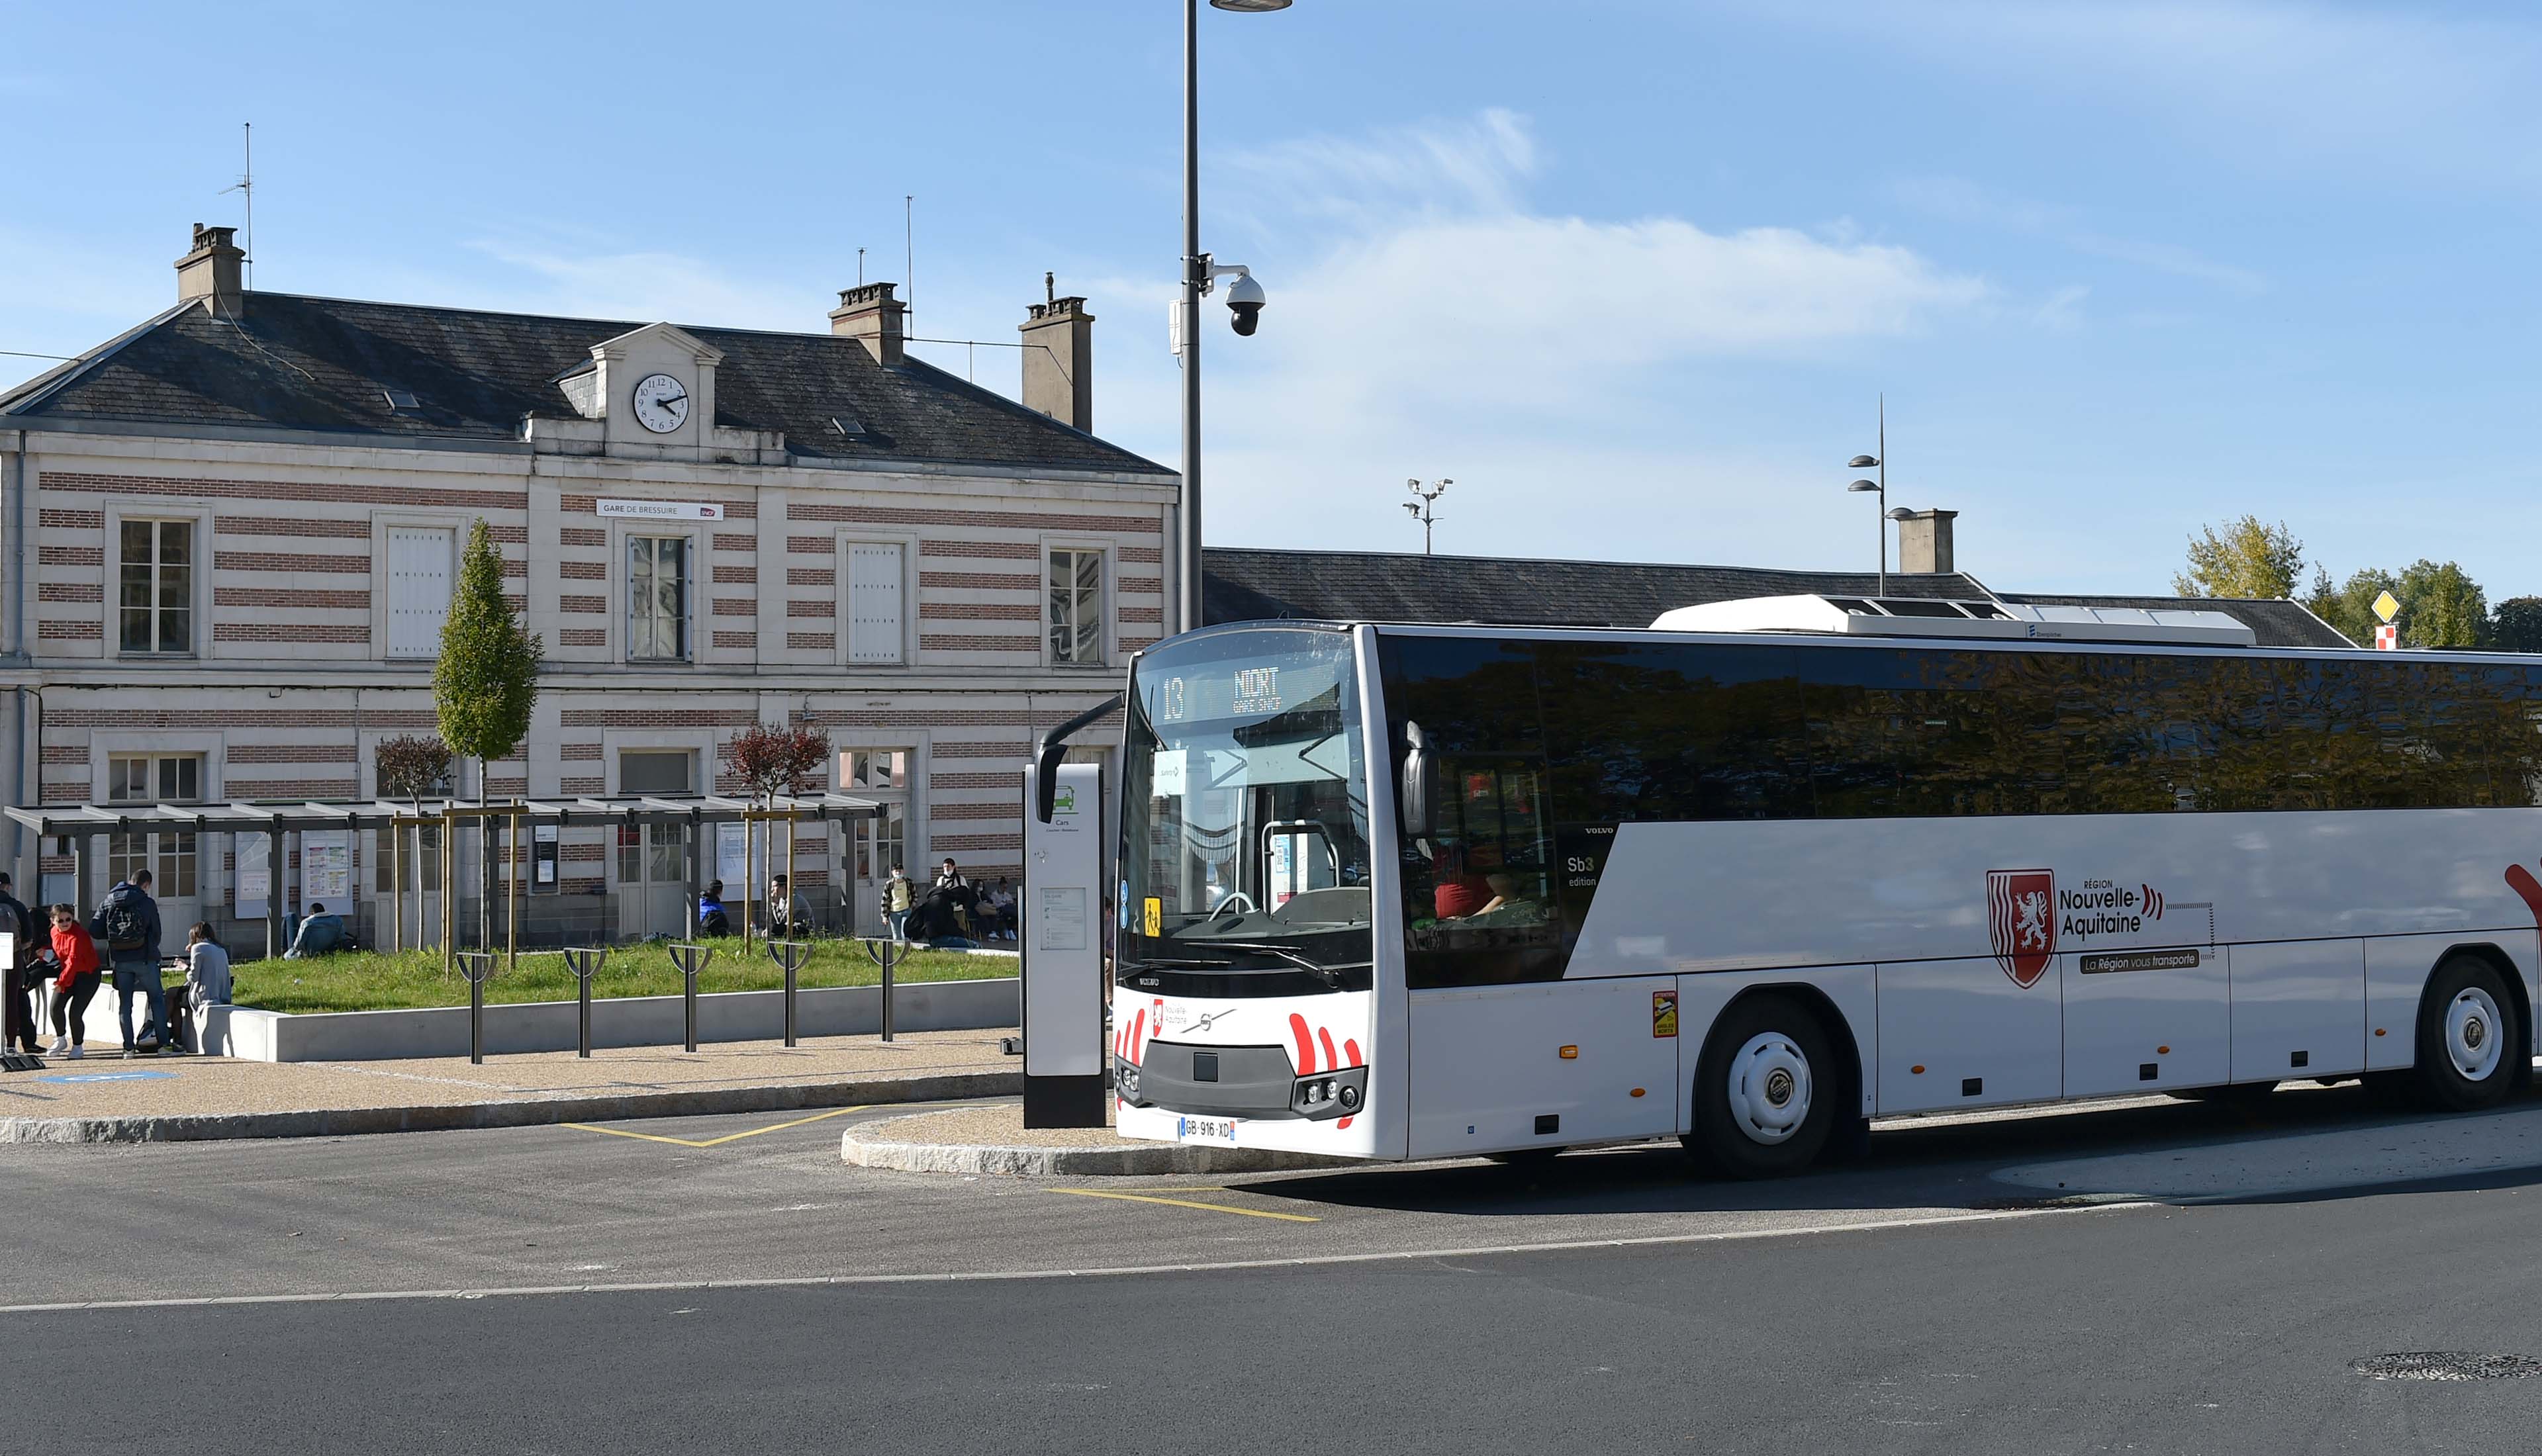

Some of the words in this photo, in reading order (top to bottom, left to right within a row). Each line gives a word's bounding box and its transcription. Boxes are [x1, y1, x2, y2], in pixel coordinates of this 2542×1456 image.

[648, 380, 655, 388] 11
[657, 378, 666, 387] 12
[640, 388, 648, 396] 10
[638, 398, 644, 407] 9
[679, 400, 684, 409] 3
[641, 410, 647, 418] 8
[649, 418, 655, 427] 7
[659, 421, 665, 430] 6
[638, 506, 678, 515] BRESSUIRE
[1234, 666, 1279, 699] NIORT
[1163, 677, 1184, 720] 13
[1233, 699, 1256, 713] GARE
[1258, 697, 1282, 712] SNCF
[1568, 857, 1595, 872] Sb3
[1569, 876, 1597, 887] edition
[2083, 878, 2113, 889] RÉGION
[2060, 887, 2140, 910] Nouvelle-
[2062, 912, 2141, 942] Aquitaine
[2085, 958, 2096, 970] La
[2098, 957, 2129, 972] Région
[2130, 958, 2151, 968] vous
[2152, 953, 2195, 968] transporte
[1139, 978, 1160, 986] VOLVO
